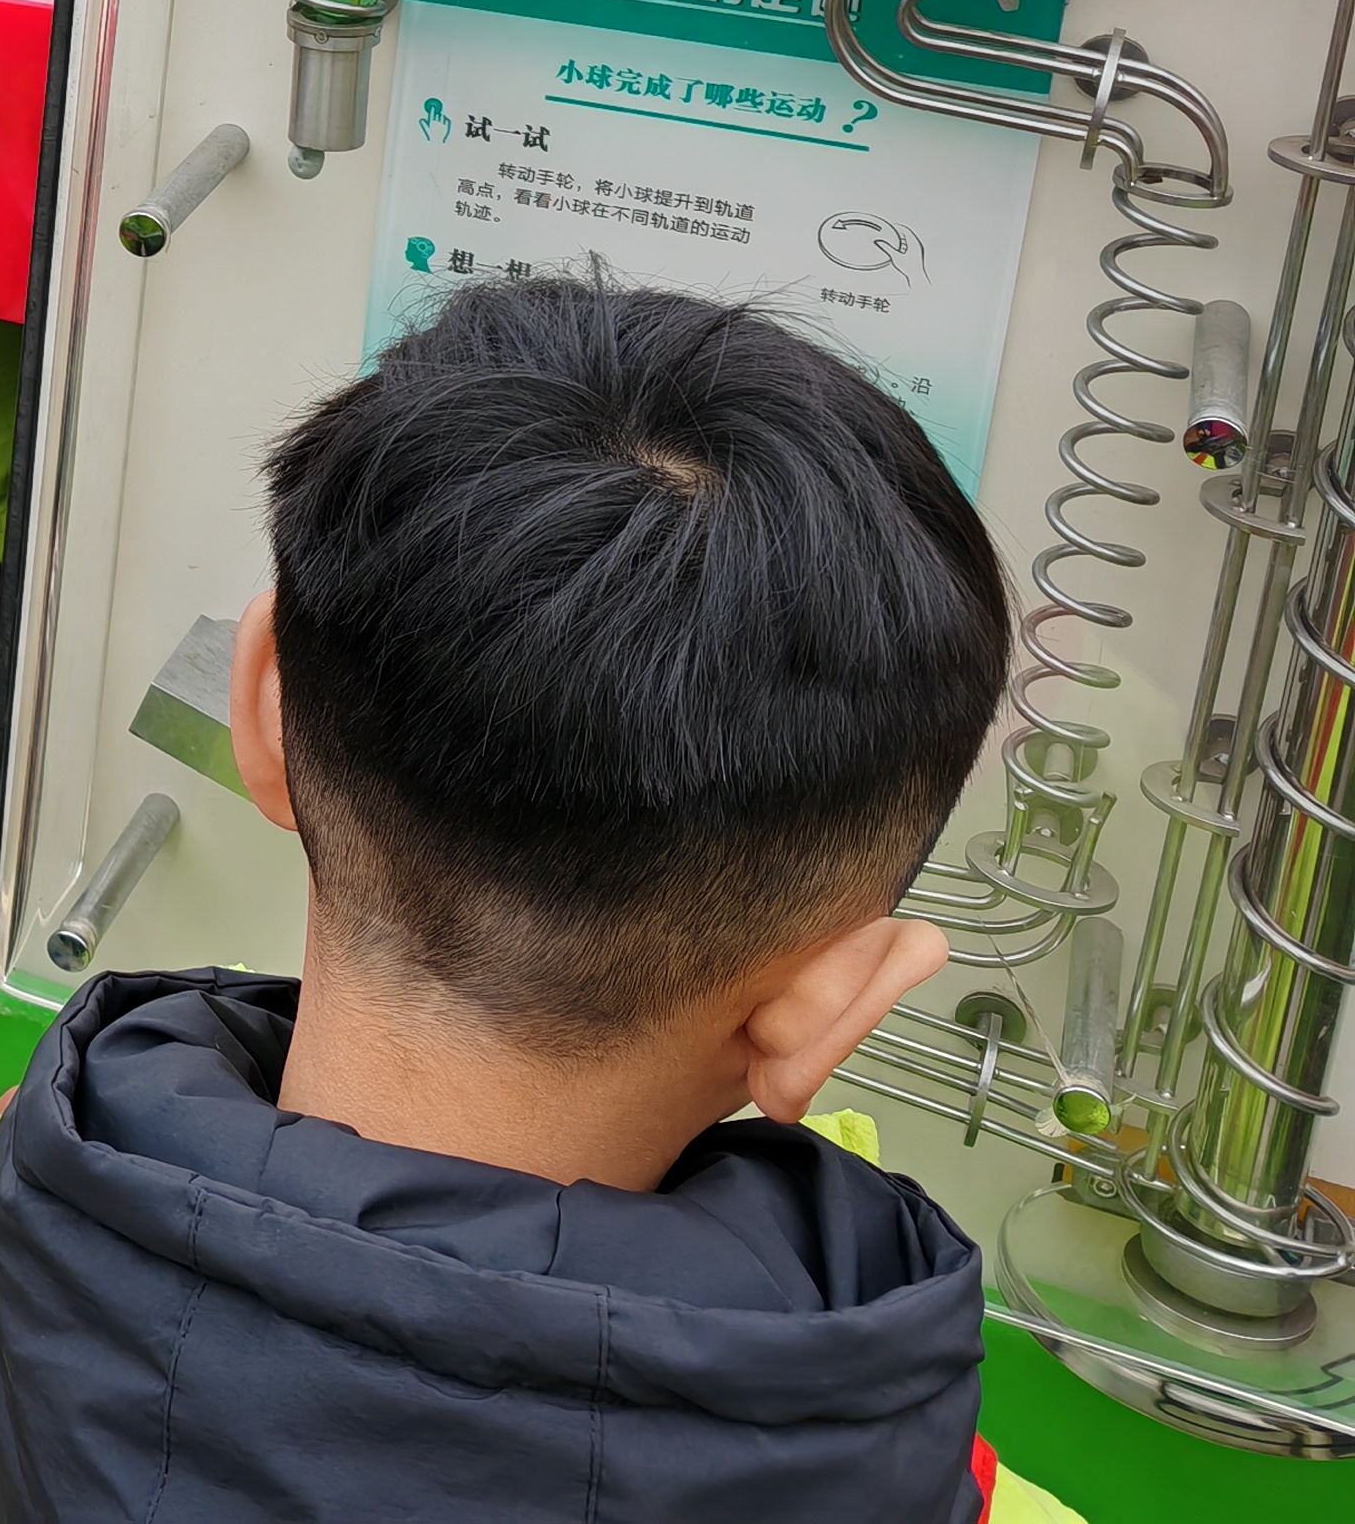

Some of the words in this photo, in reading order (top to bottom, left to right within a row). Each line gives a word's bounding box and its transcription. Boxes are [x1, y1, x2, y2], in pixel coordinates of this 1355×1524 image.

[464, 114, 551, 152] 试一试
[497, 161, 756, 222] 转动手轮，将小球提升到轨道
[453, 199, 501, 224] 轨迹。
[456, 177, 751, 245] 高点，看看小球在不同轨道的运动
[820, 287, 891, 313] 转动手轮
